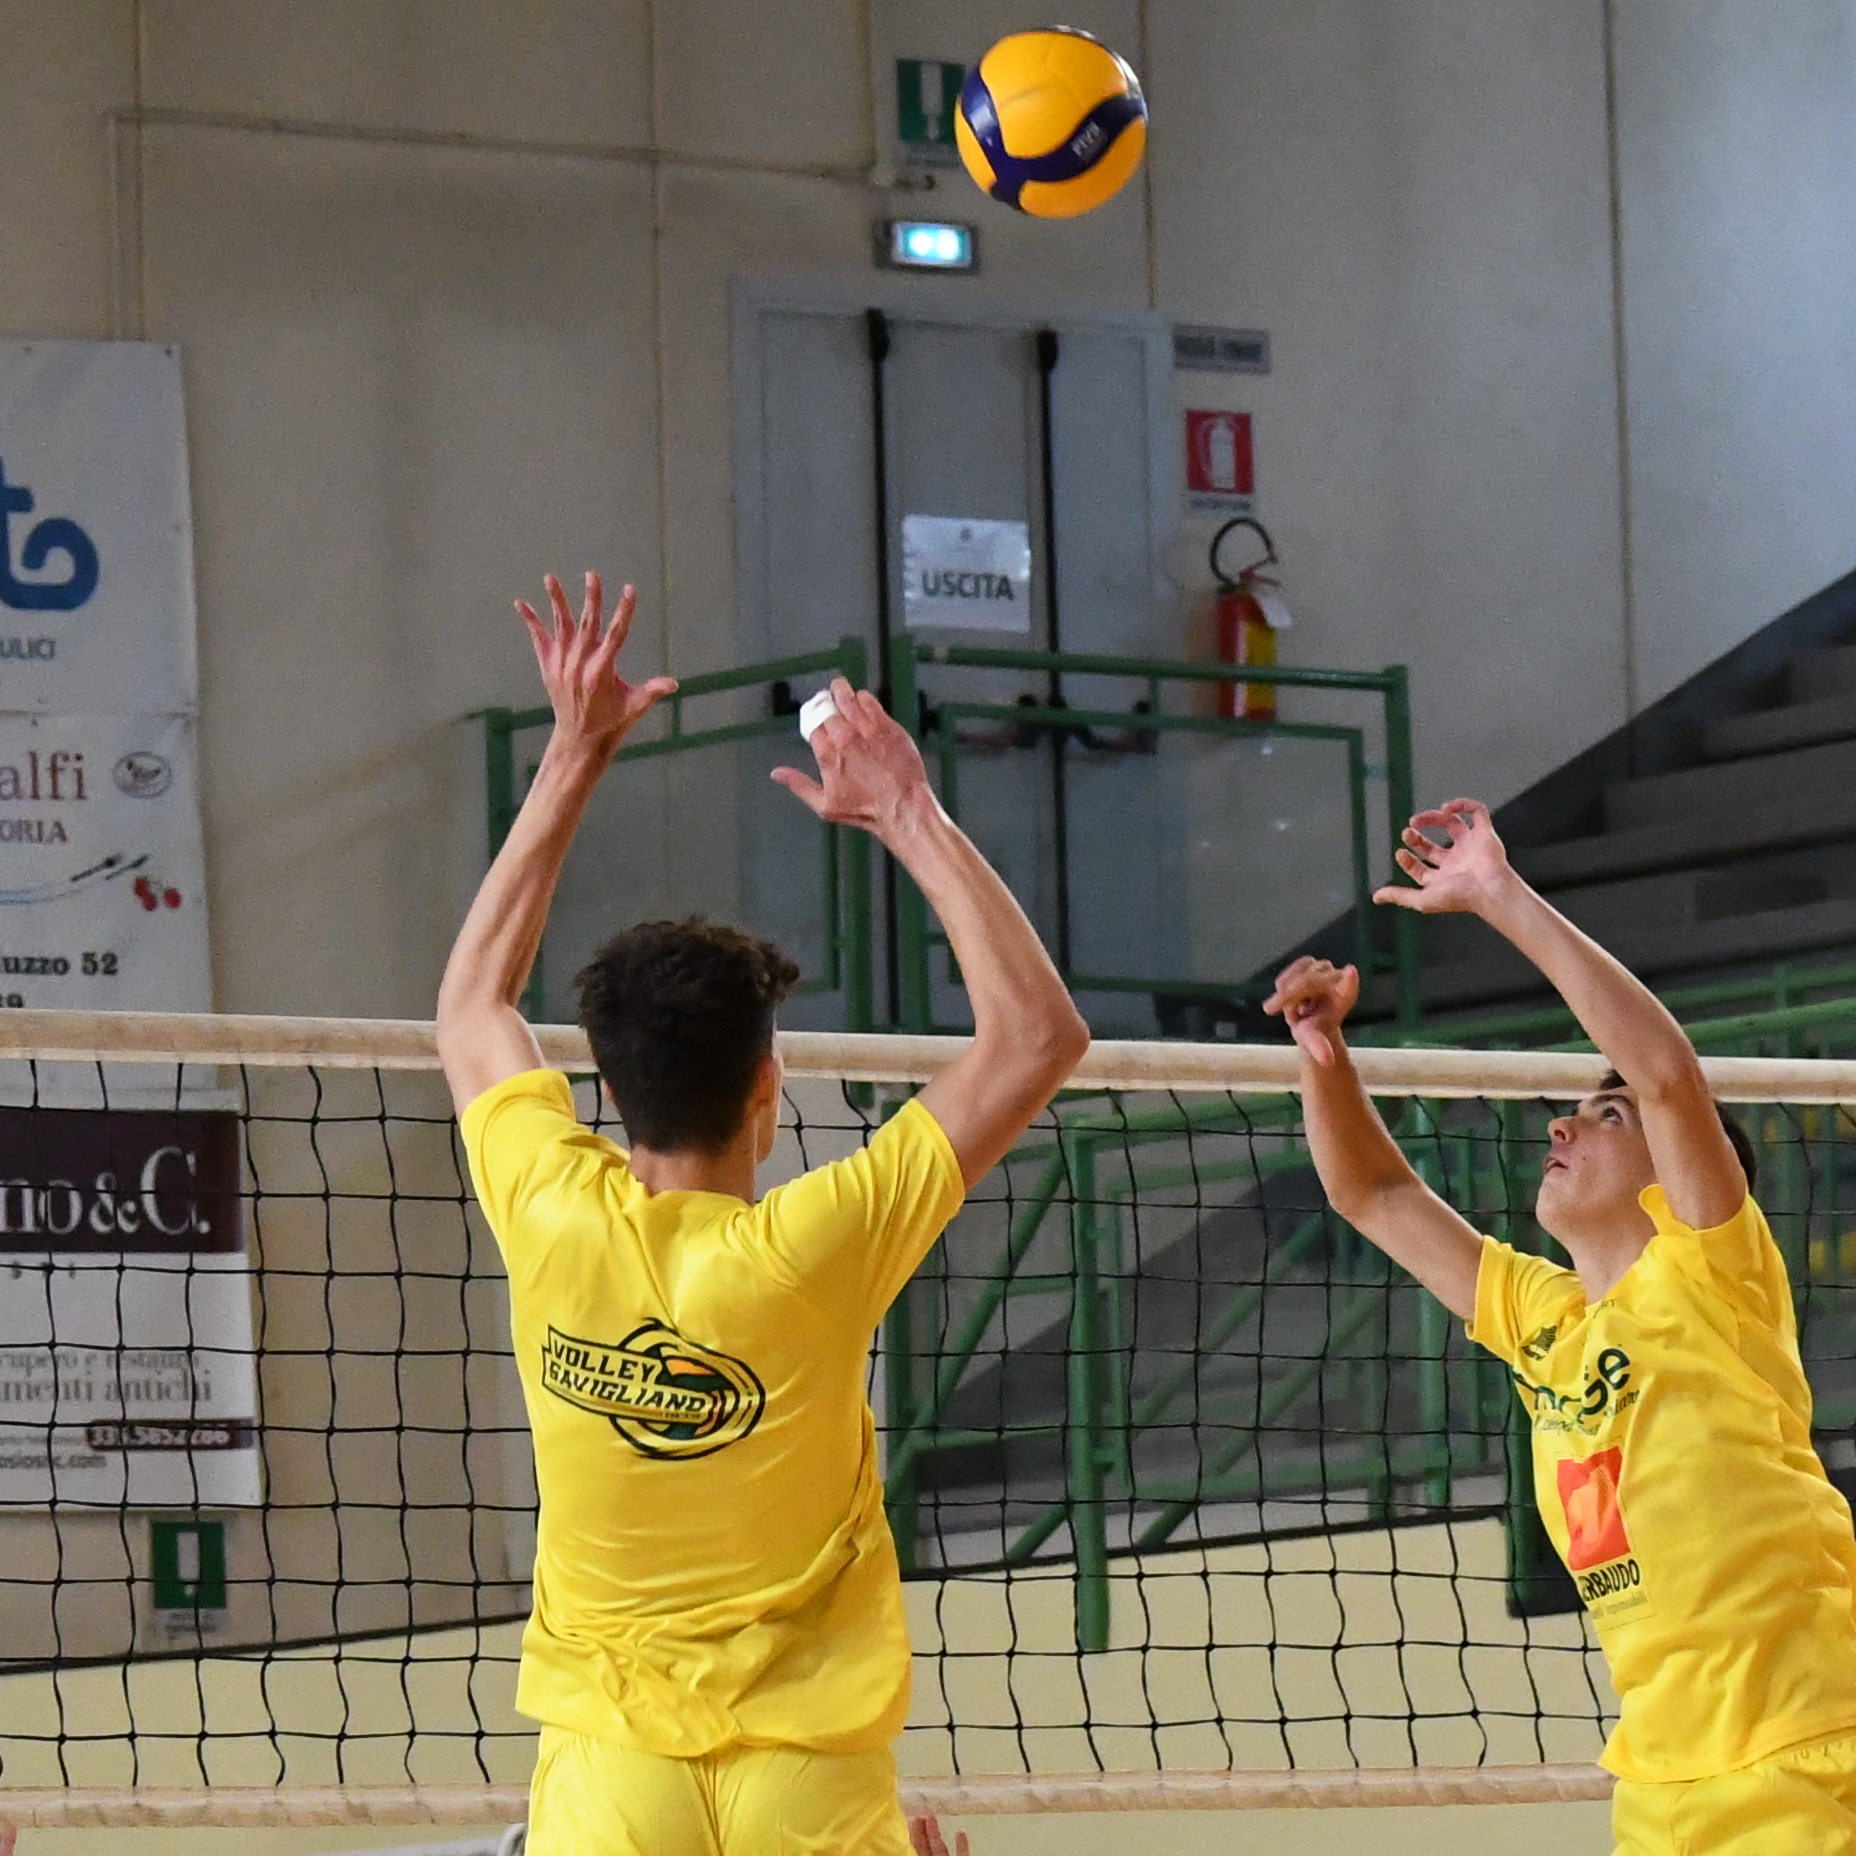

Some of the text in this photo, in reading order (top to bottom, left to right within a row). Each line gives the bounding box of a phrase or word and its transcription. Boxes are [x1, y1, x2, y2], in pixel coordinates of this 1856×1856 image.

[921, 569, 1015, 603] USCITA
[81, 951, 119, 976] 52
[88, 1172, 141, 1233] &
[552, 1338, 658, 1385] VOLLEY
[549, 1360, 707, 1413] SAVIGLIANO
